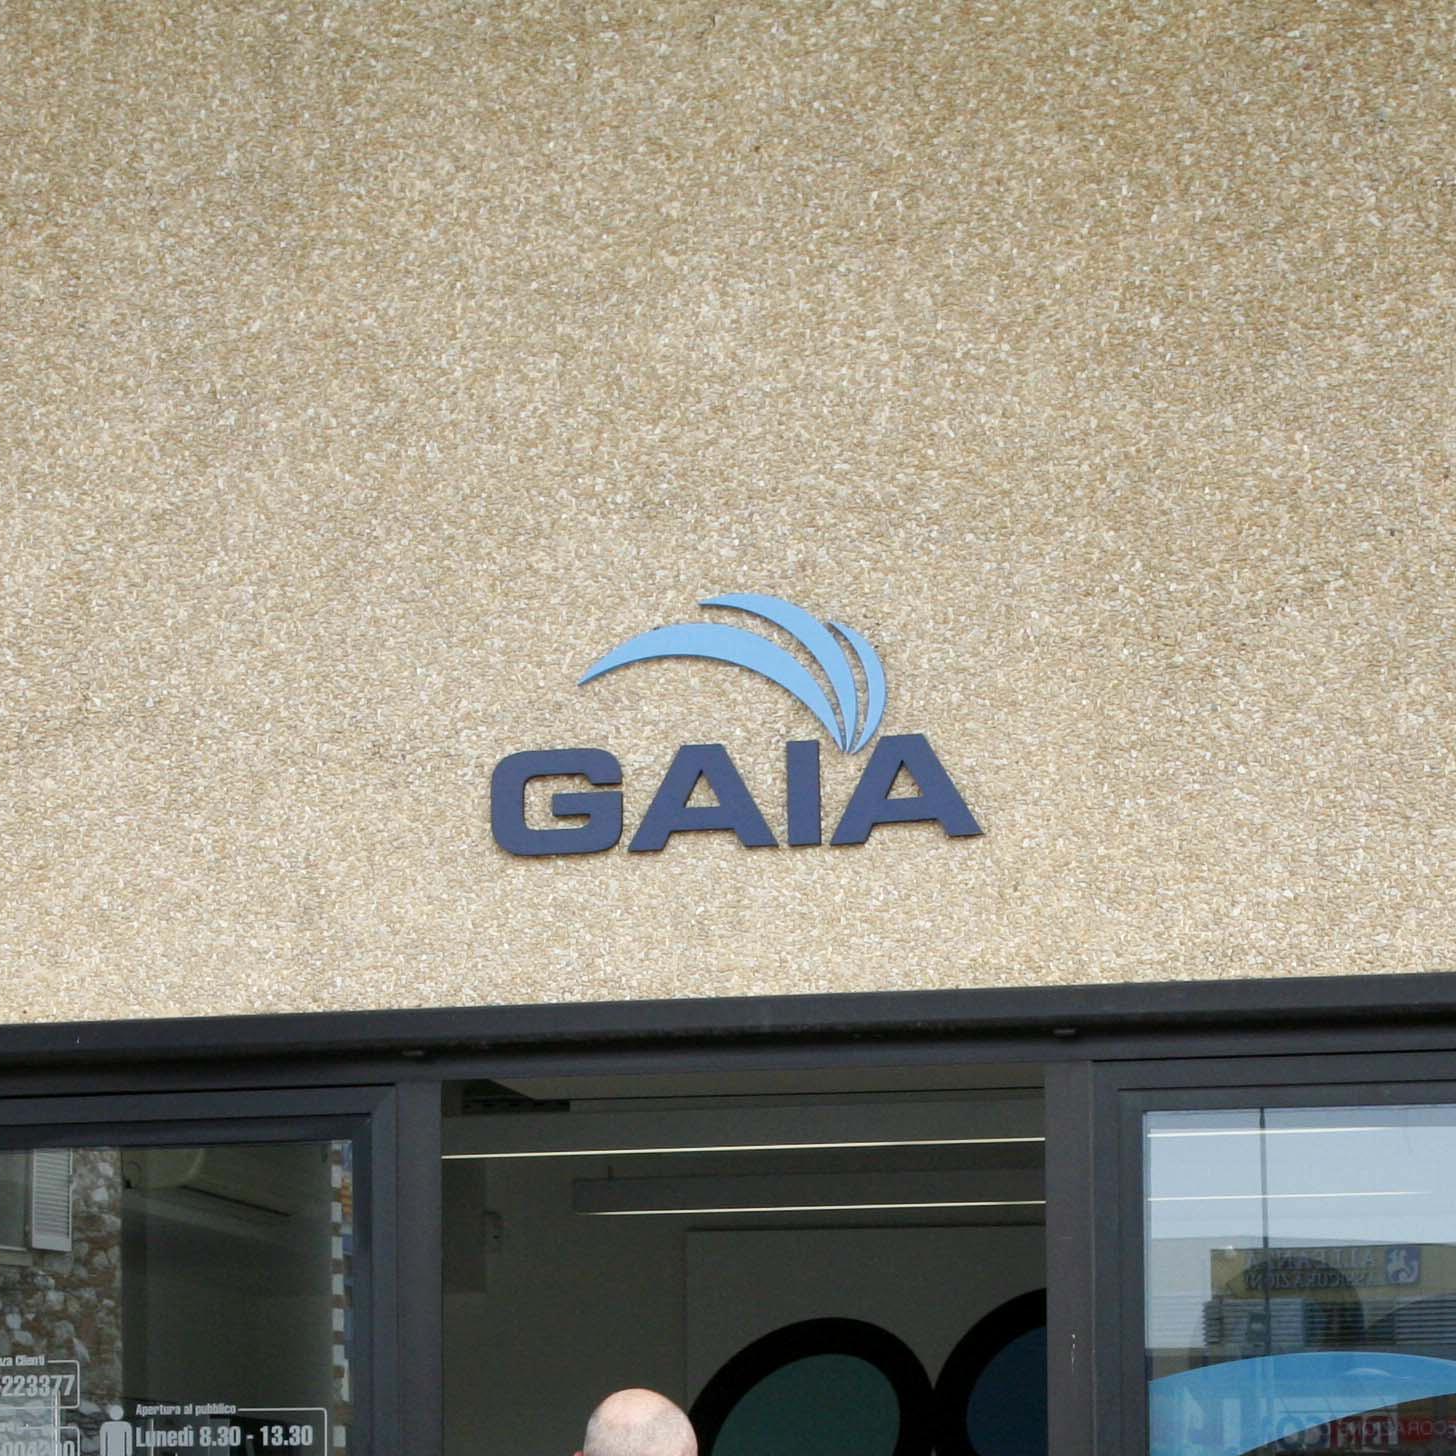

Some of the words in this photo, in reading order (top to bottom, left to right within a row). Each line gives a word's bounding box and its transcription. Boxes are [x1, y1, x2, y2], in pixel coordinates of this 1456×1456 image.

[490, 732, 985, 857] GAIA
[136, 1404, 181, 1416] Apertura
[183, 1404, 193, 1414] al
[195, 1403, 237, 1416] pubblico
[136, 1425, 194, 1447] Lunedì
[199, 1425, 241, 1447] 8.30
[260, 1425, 313, 1447] 13.30
